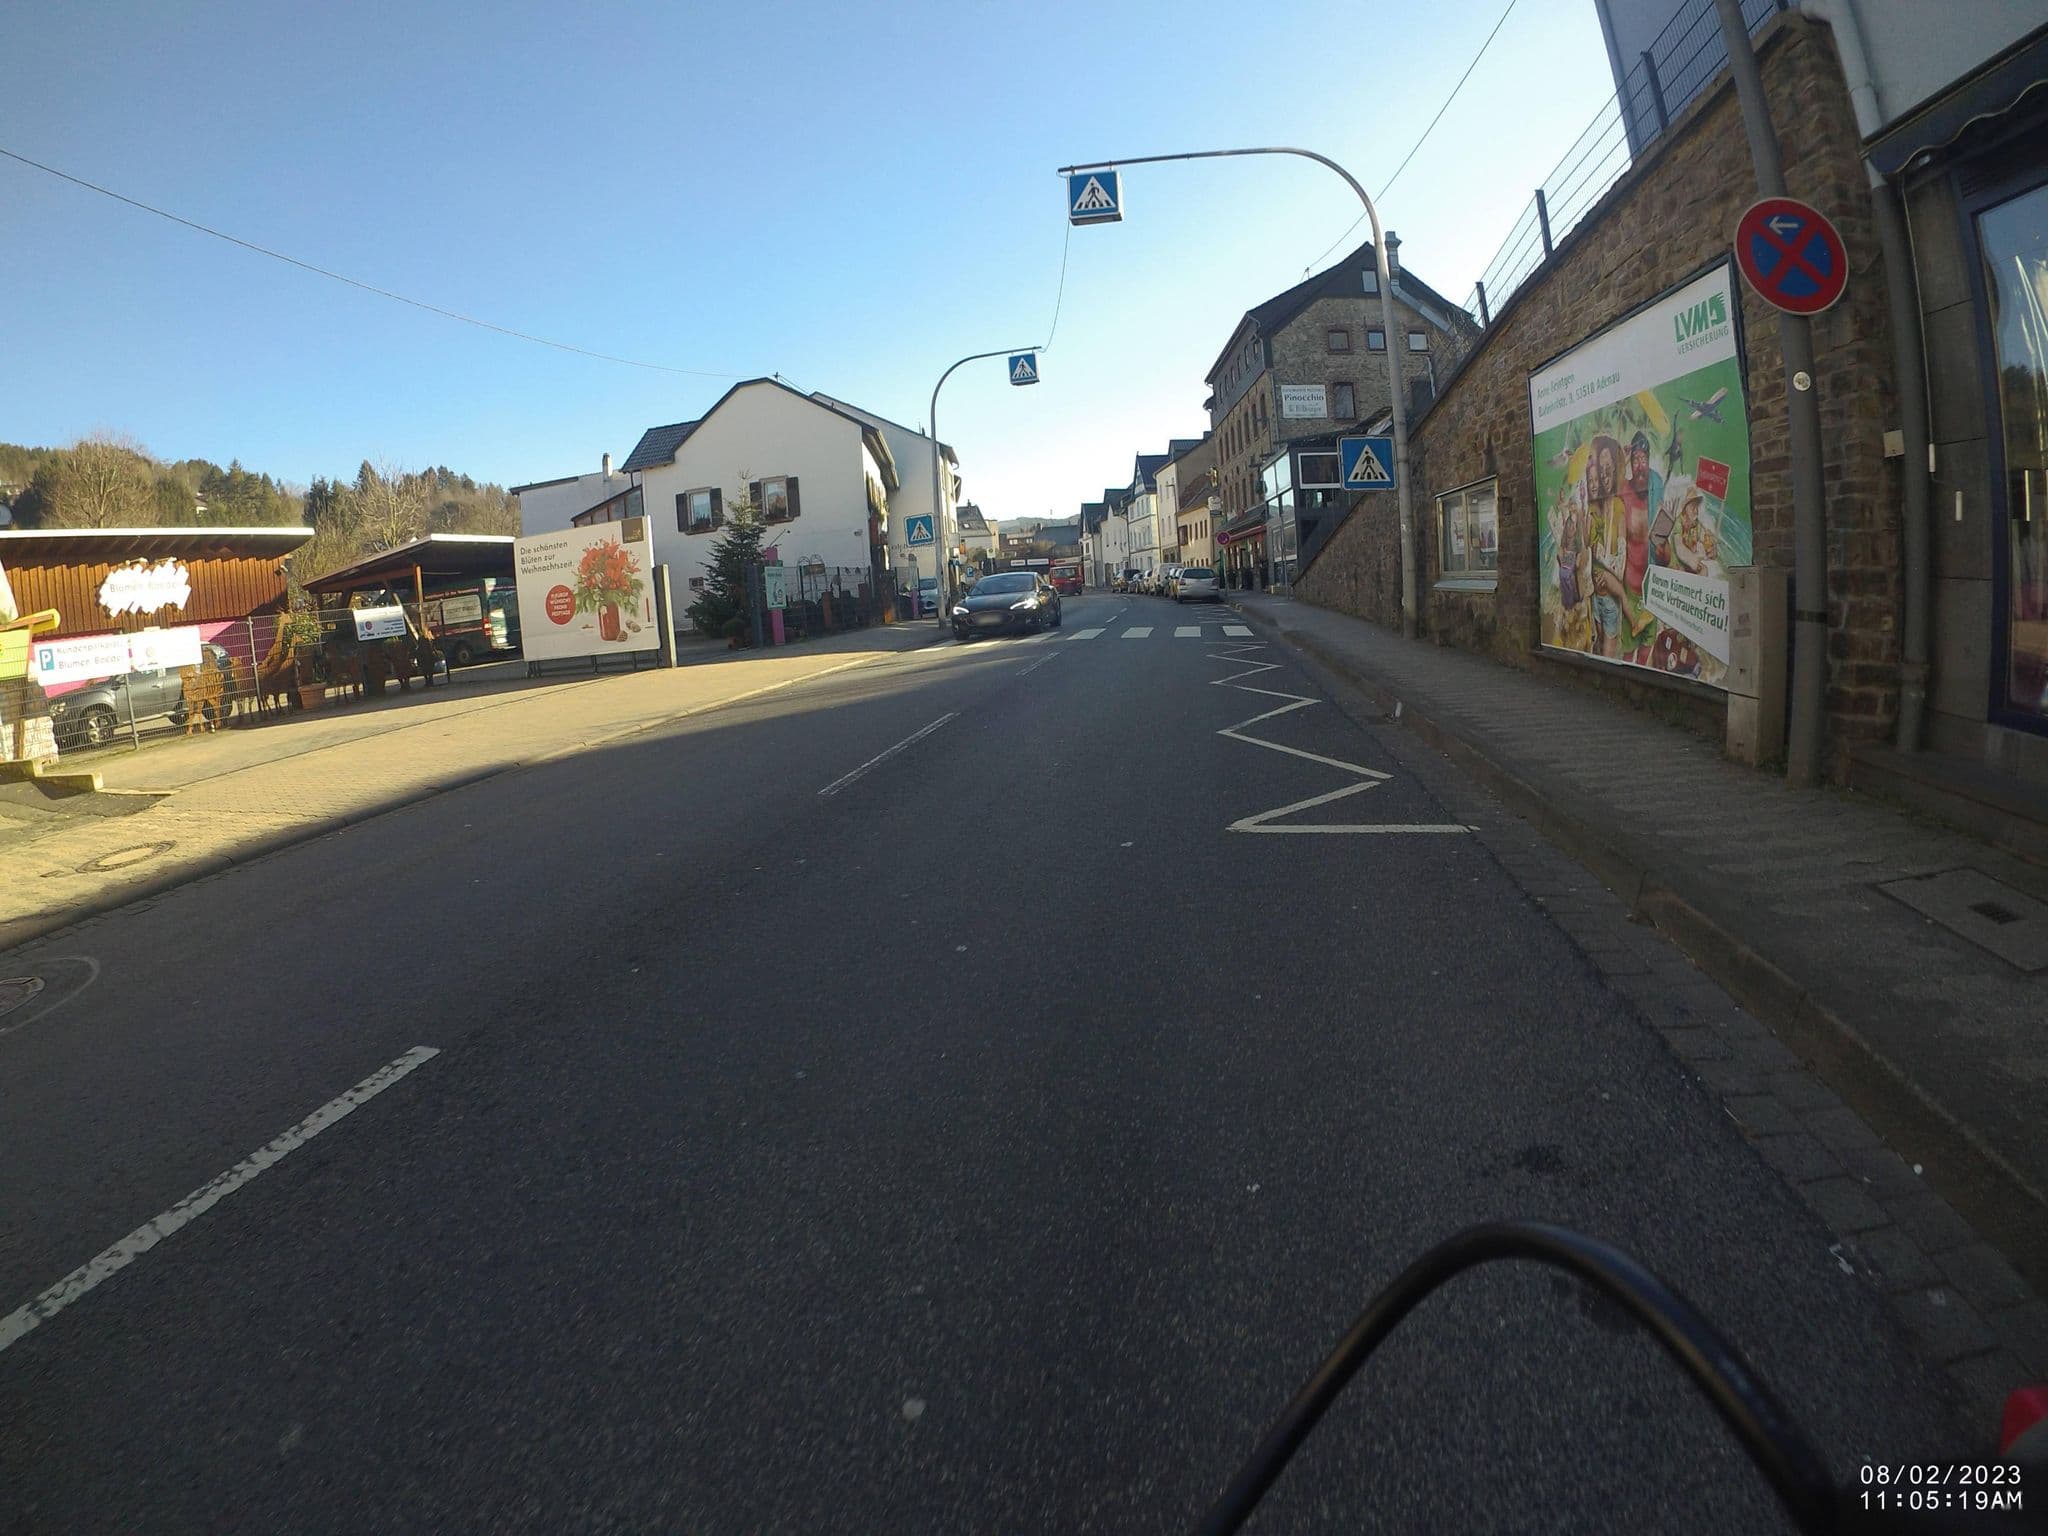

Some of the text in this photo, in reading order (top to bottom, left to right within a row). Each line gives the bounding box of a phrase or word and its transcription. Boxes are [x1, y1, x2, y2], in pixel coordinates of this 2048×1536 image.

[1676, 326, 1729, 354] VERSICHERUNG
[1284, 393, 1325, 401] Pinocchio
[520, 541, 568, 555] Die schönsten
[520, 554, 543, 565] Blüten
[1670, 577, 1703, 602] kümmert
[1704, 590, 1726, 611] sich
[1666, 591, 1729, 632] Vertrauensfrau!
